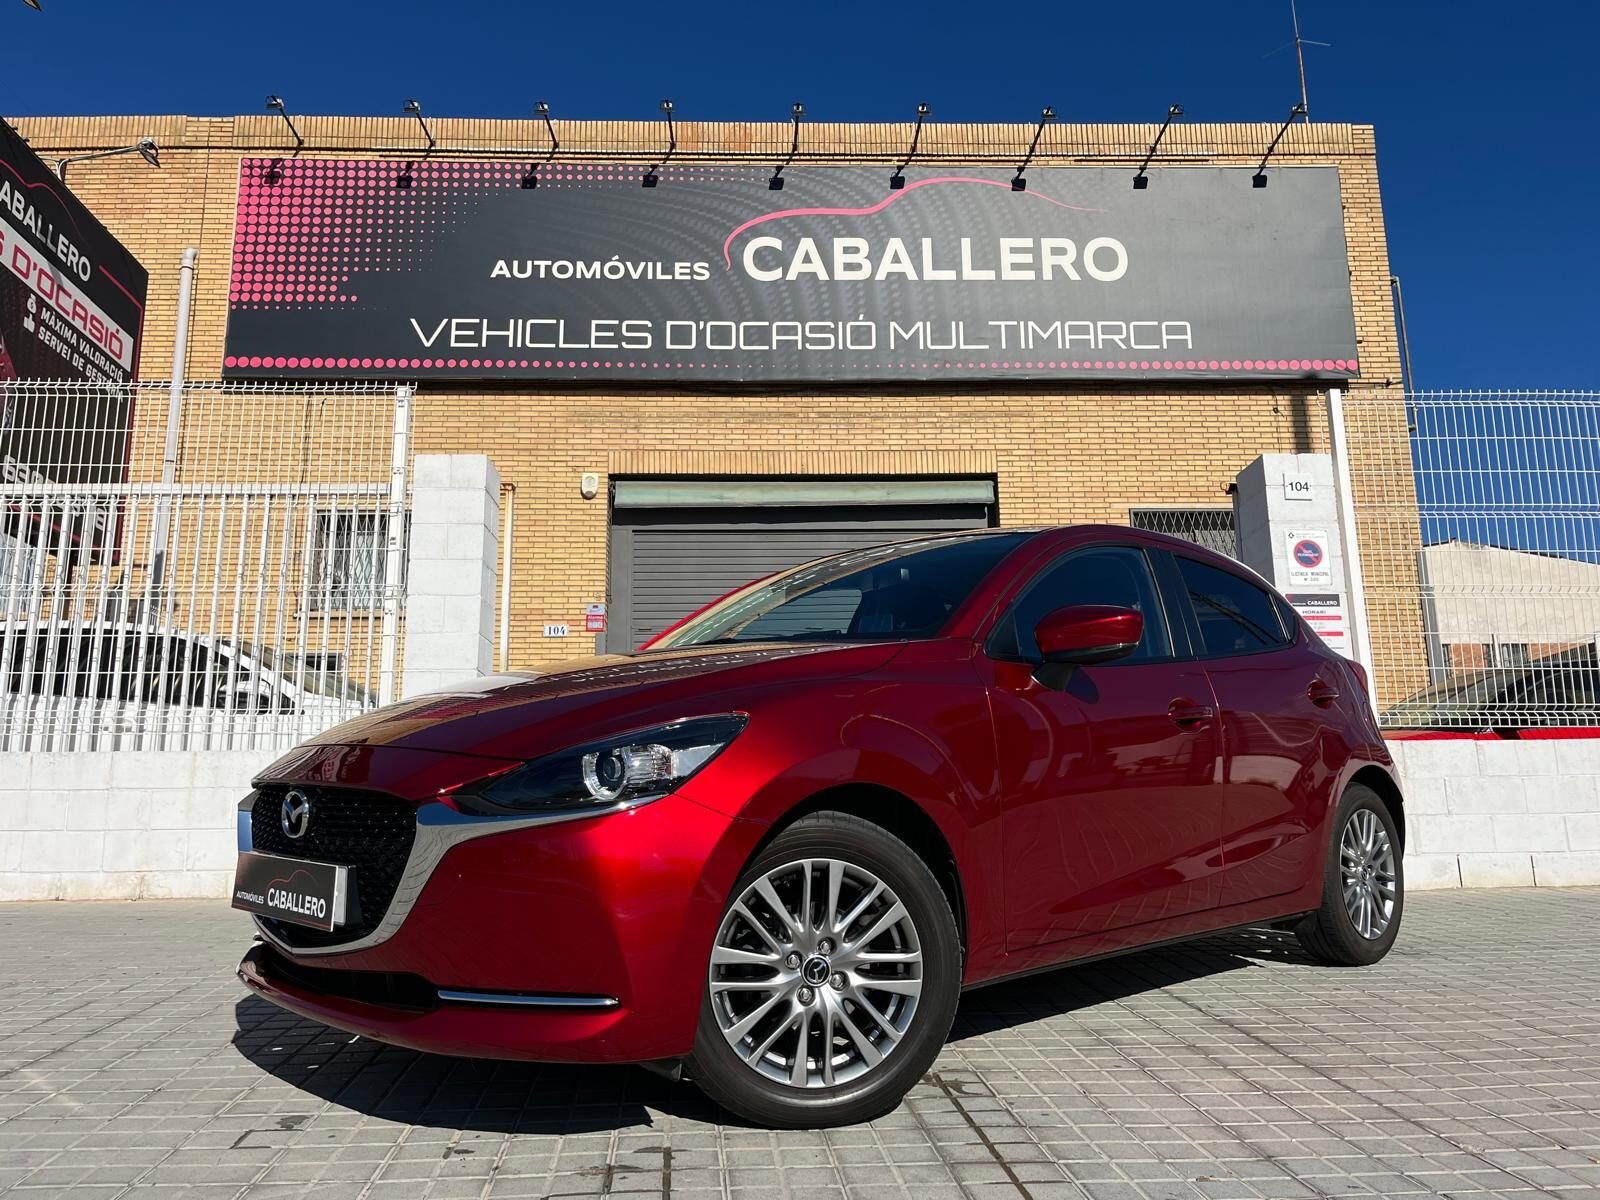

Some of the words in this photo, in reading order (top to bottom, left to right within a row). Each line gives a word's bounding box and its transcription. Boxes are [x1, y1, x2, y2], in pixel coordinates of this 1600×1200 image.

[490, 254, 710, 281] AUTOMÓVILES
[743, 236, 1128, 281] CABALLERO
[11, 243, 123, 361] D'OCASIÓ
[38, 325, 72, 361] SERVEI
[72, 352, 85, 372] DE
[40, 307, 77, 347] MÀXIMA
[79, 338, 123, 382] VALORACIÓ
[410, 318, 652, 349] VEHICLES
[666, 314, 876, 350] D'OCASIÓ
[889, 320, 1192, 350] MULTIMARCA
[1288, 481, 1310, 492] 104
[547, 626, 566, 636] 104
[236, 890, 265, 905] AUTOMÓVILES
[267, 887, 326, 919] CABALLERO
